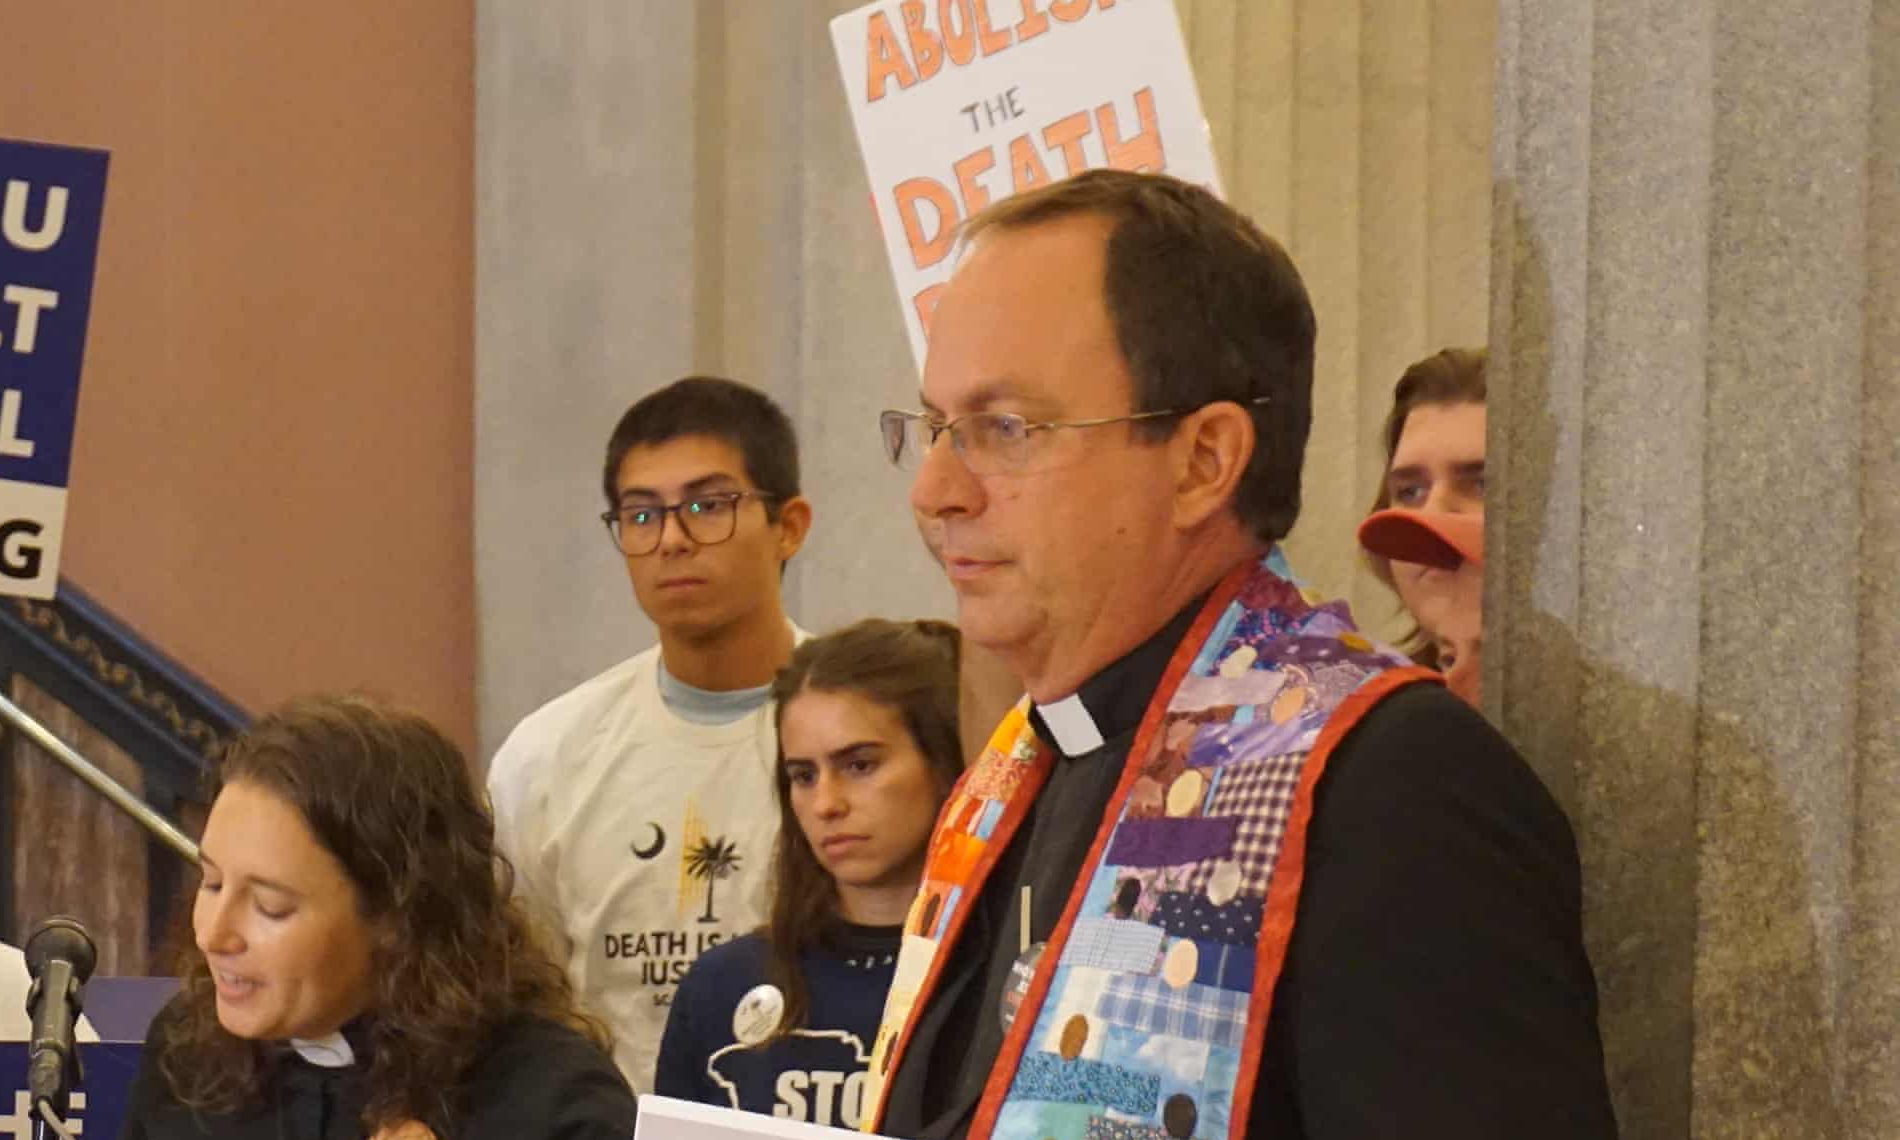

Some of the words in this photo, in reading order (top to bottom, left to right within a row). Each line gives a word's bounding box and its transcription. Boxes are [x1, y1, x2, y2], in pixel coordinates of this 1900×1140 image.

[866, 0, 1116, 103] ABOLI
[960, 86, 1026, 134] THE
[892, 86, 1167, 271] DEATH
[604, 931, 687, 959] DEATH
